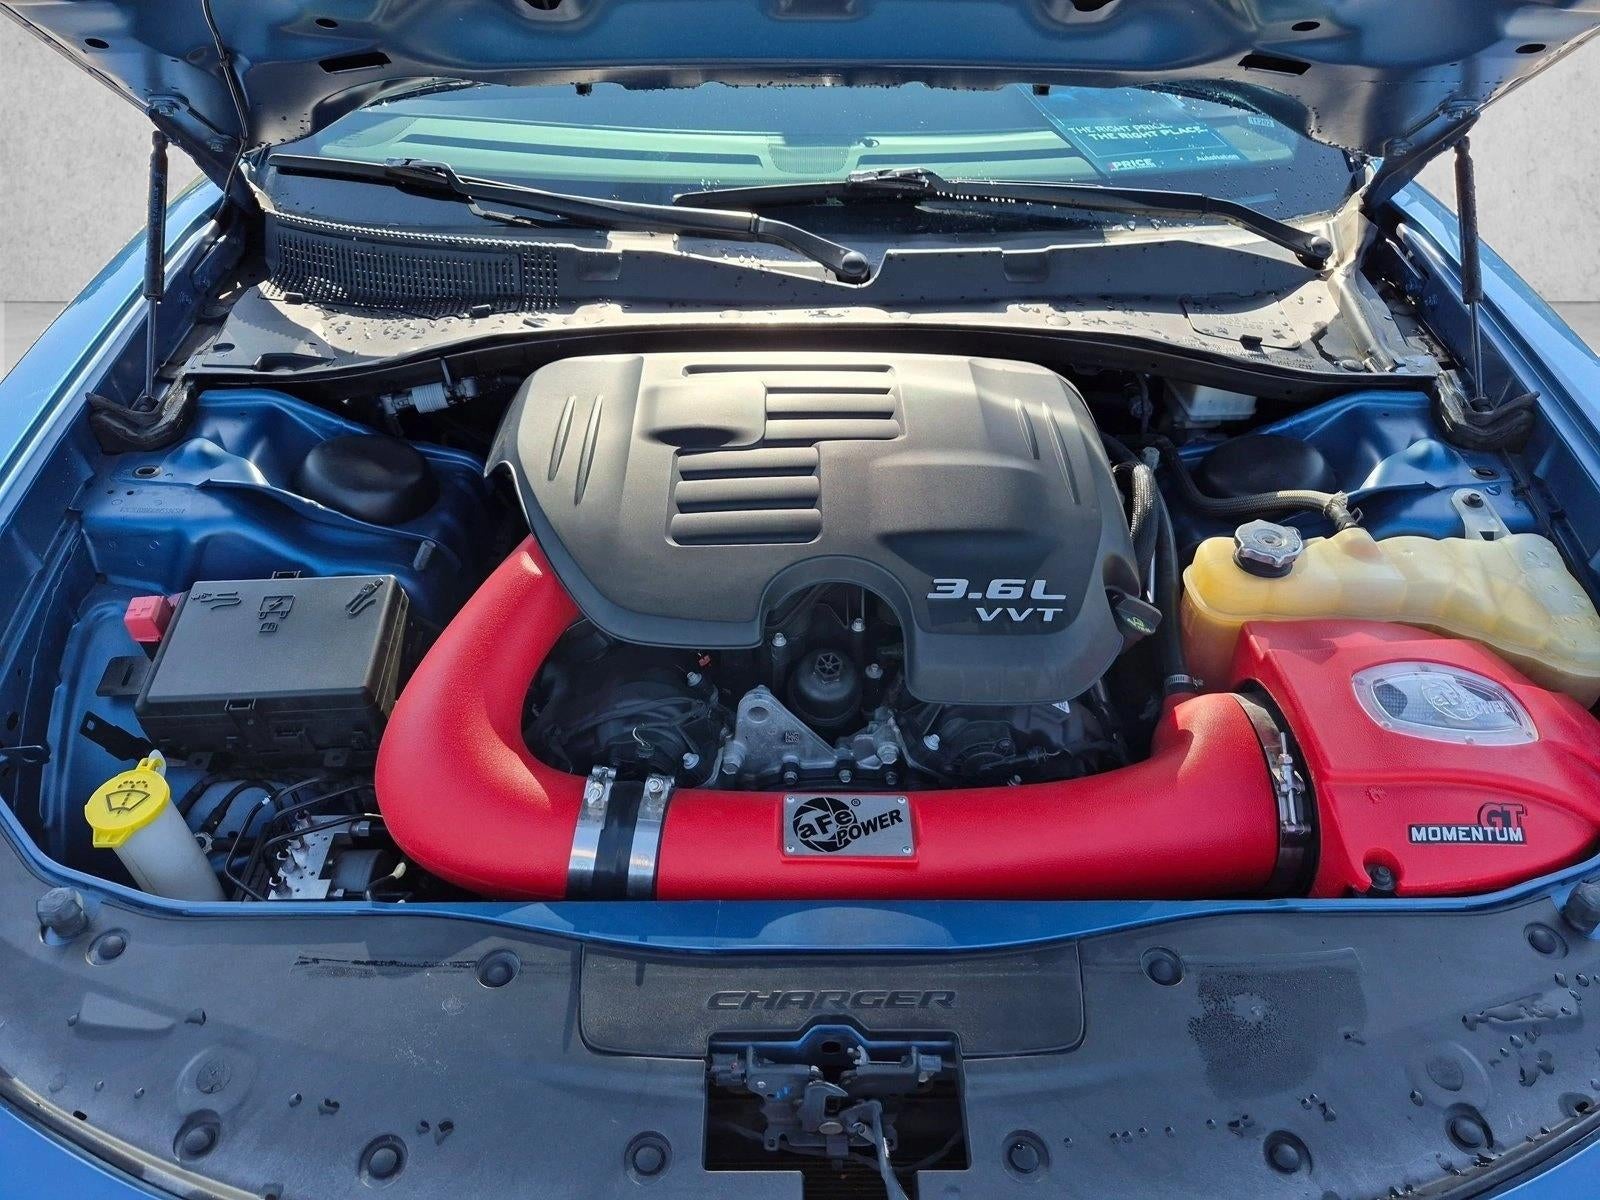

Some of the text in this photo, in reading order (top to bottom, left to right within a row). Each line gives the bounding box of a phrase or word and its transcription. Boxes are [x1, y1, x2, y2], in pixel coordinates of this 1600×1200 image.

[1067, 126, 1095, 135] THE
[1095, 125, 1130, 133] RIGHT
[1088, 132, 1118, 141] THE
[1118, 130, 1158, 139] RIGHT
[927, 578, 1066, 600] 3.6L
[975, 607, 1063, 622] VVT
[1478, 802, 1527, 829] GT
[836, 808, 903, 847] POWER
[1411, 826, 1523, 842] MOMENTUM
[706, 989, 956, 1010] CHARGER
